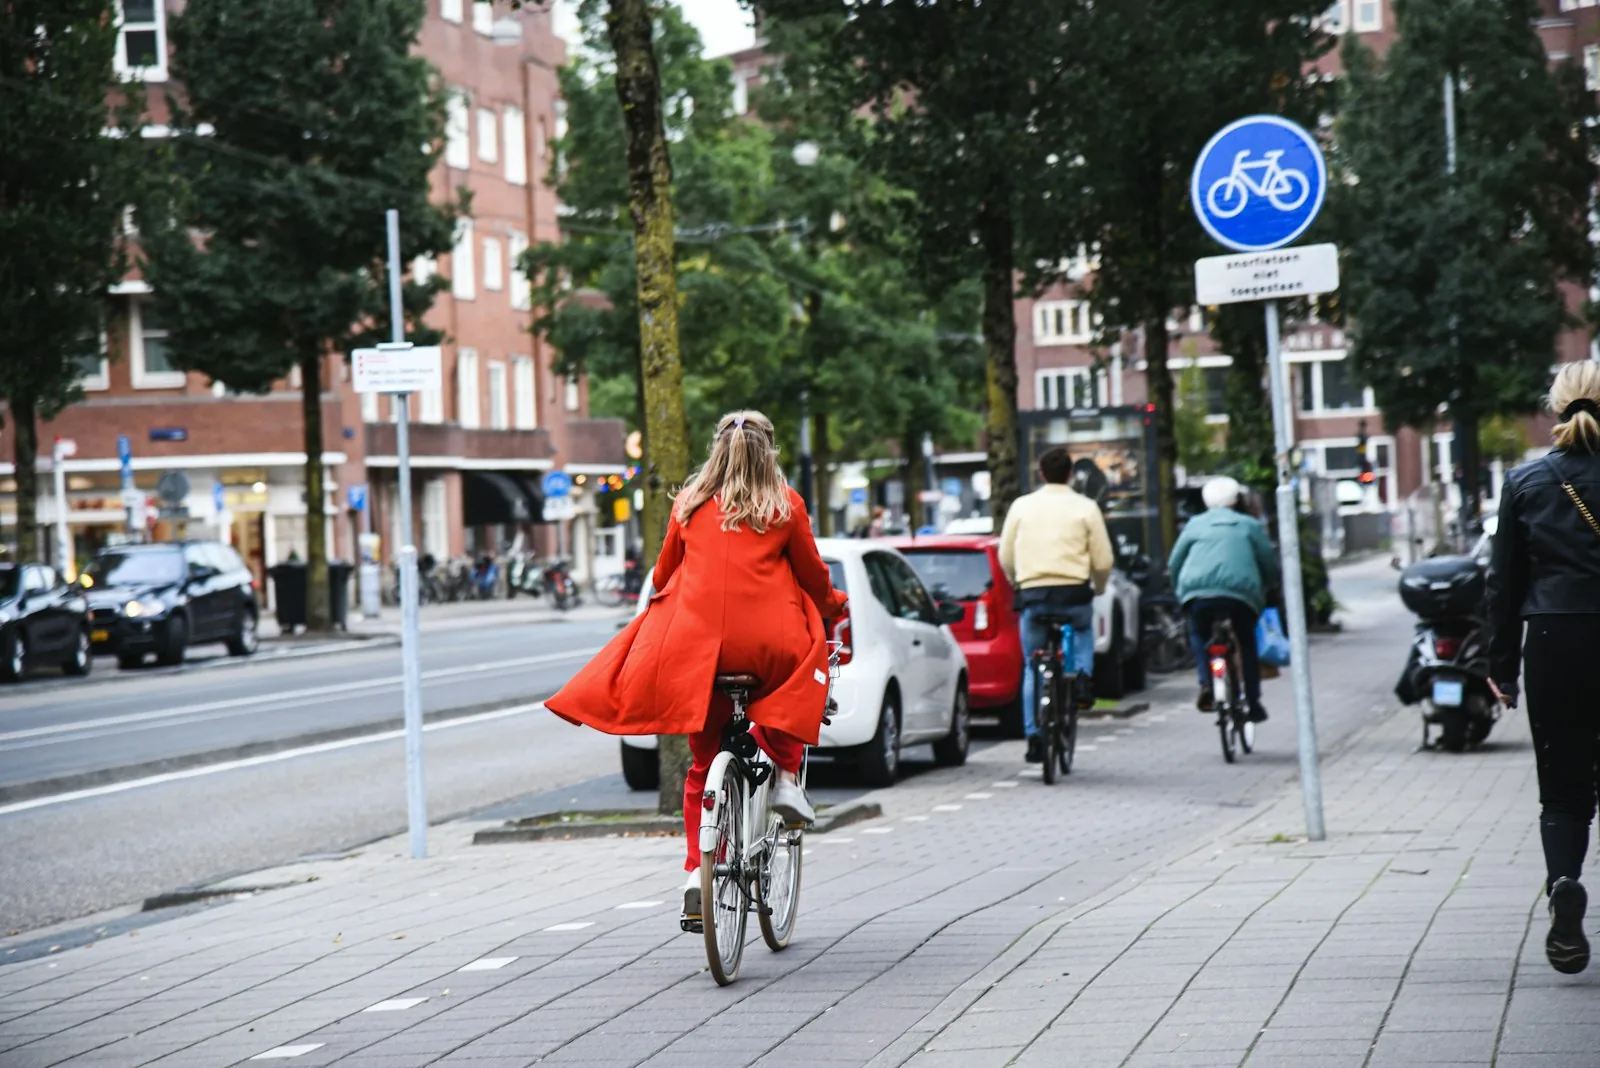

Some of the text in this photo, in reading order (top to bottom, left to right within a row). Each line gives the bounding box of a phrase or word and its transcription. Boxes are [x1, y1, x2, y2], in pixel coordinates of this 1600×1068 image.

[1227, 255, 1299, 269] snorfietsen
[1253, 269, 1278, 279] niet
[1231, 282, 1302, 297] toegestaan
